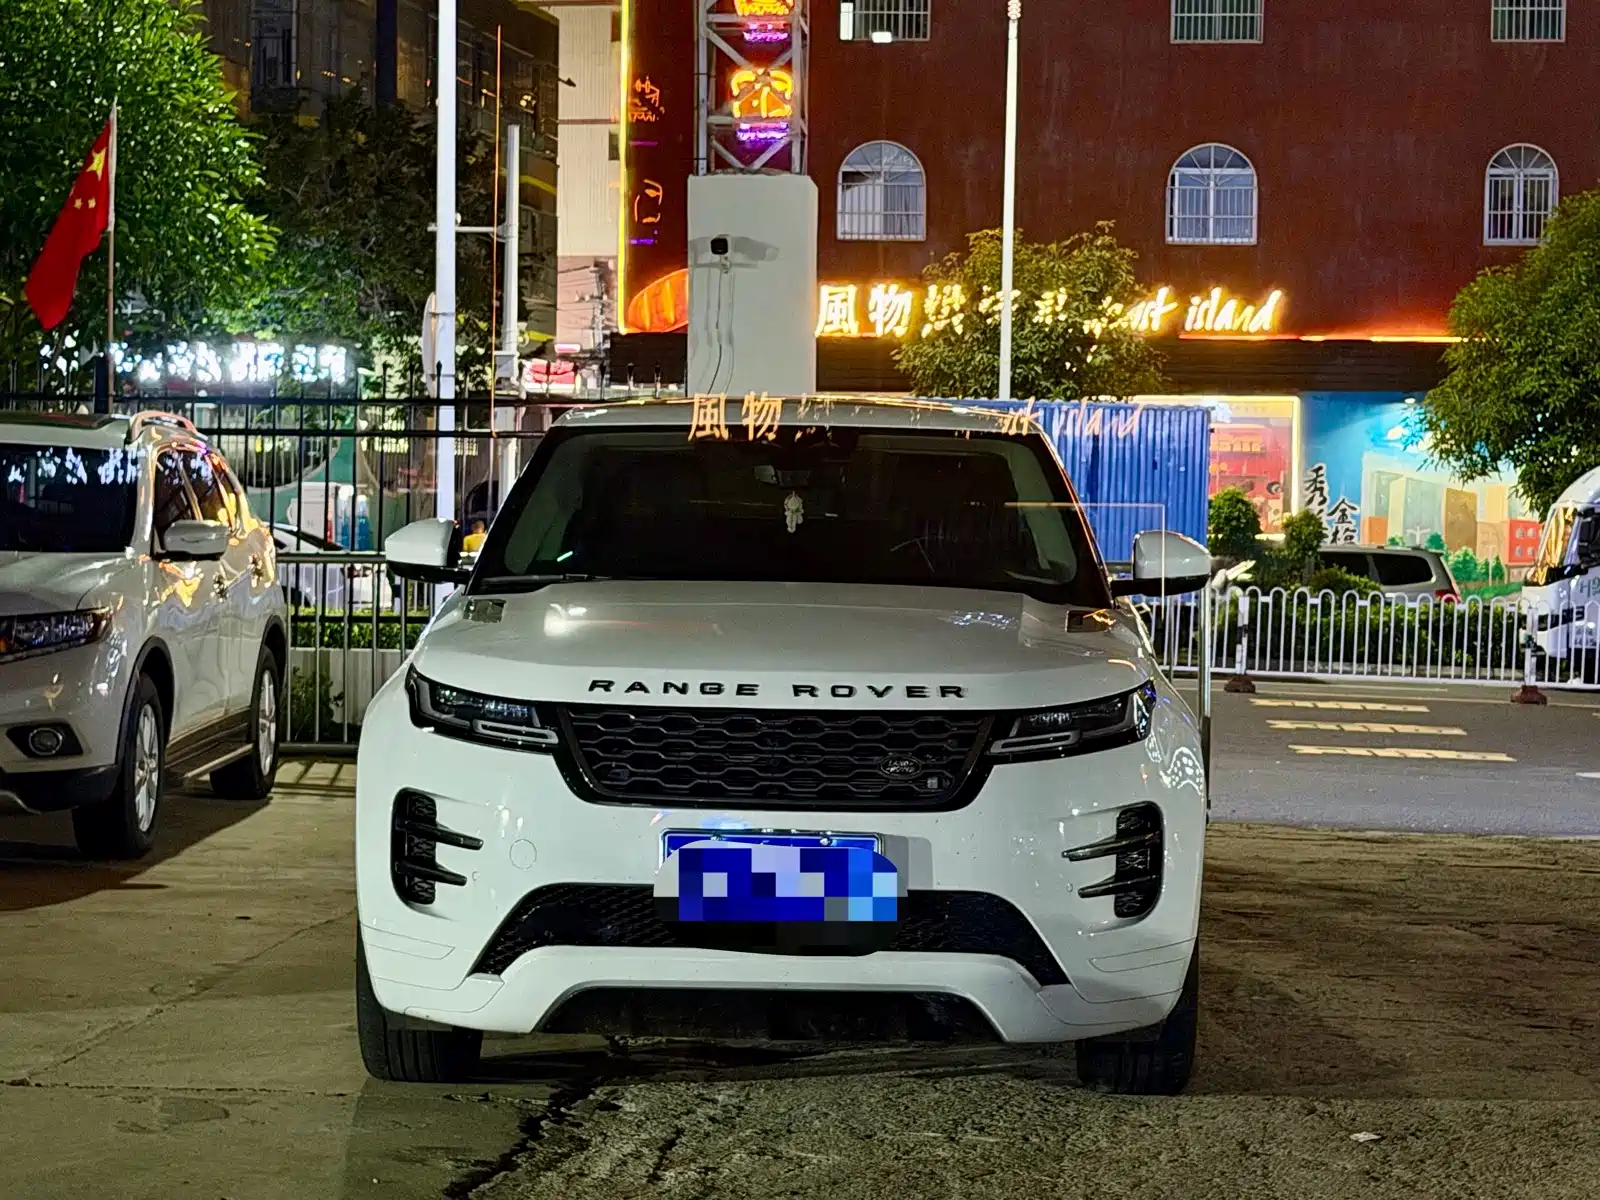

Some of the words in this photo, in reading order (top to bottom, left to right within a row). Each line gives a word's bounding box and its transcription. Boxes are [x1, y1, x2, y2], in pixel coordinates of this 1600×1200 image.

[1185, 287, 1282, 332] island
[588, 679, 760, 696] RANGE
[792, 684, 965, 698] ROVER
